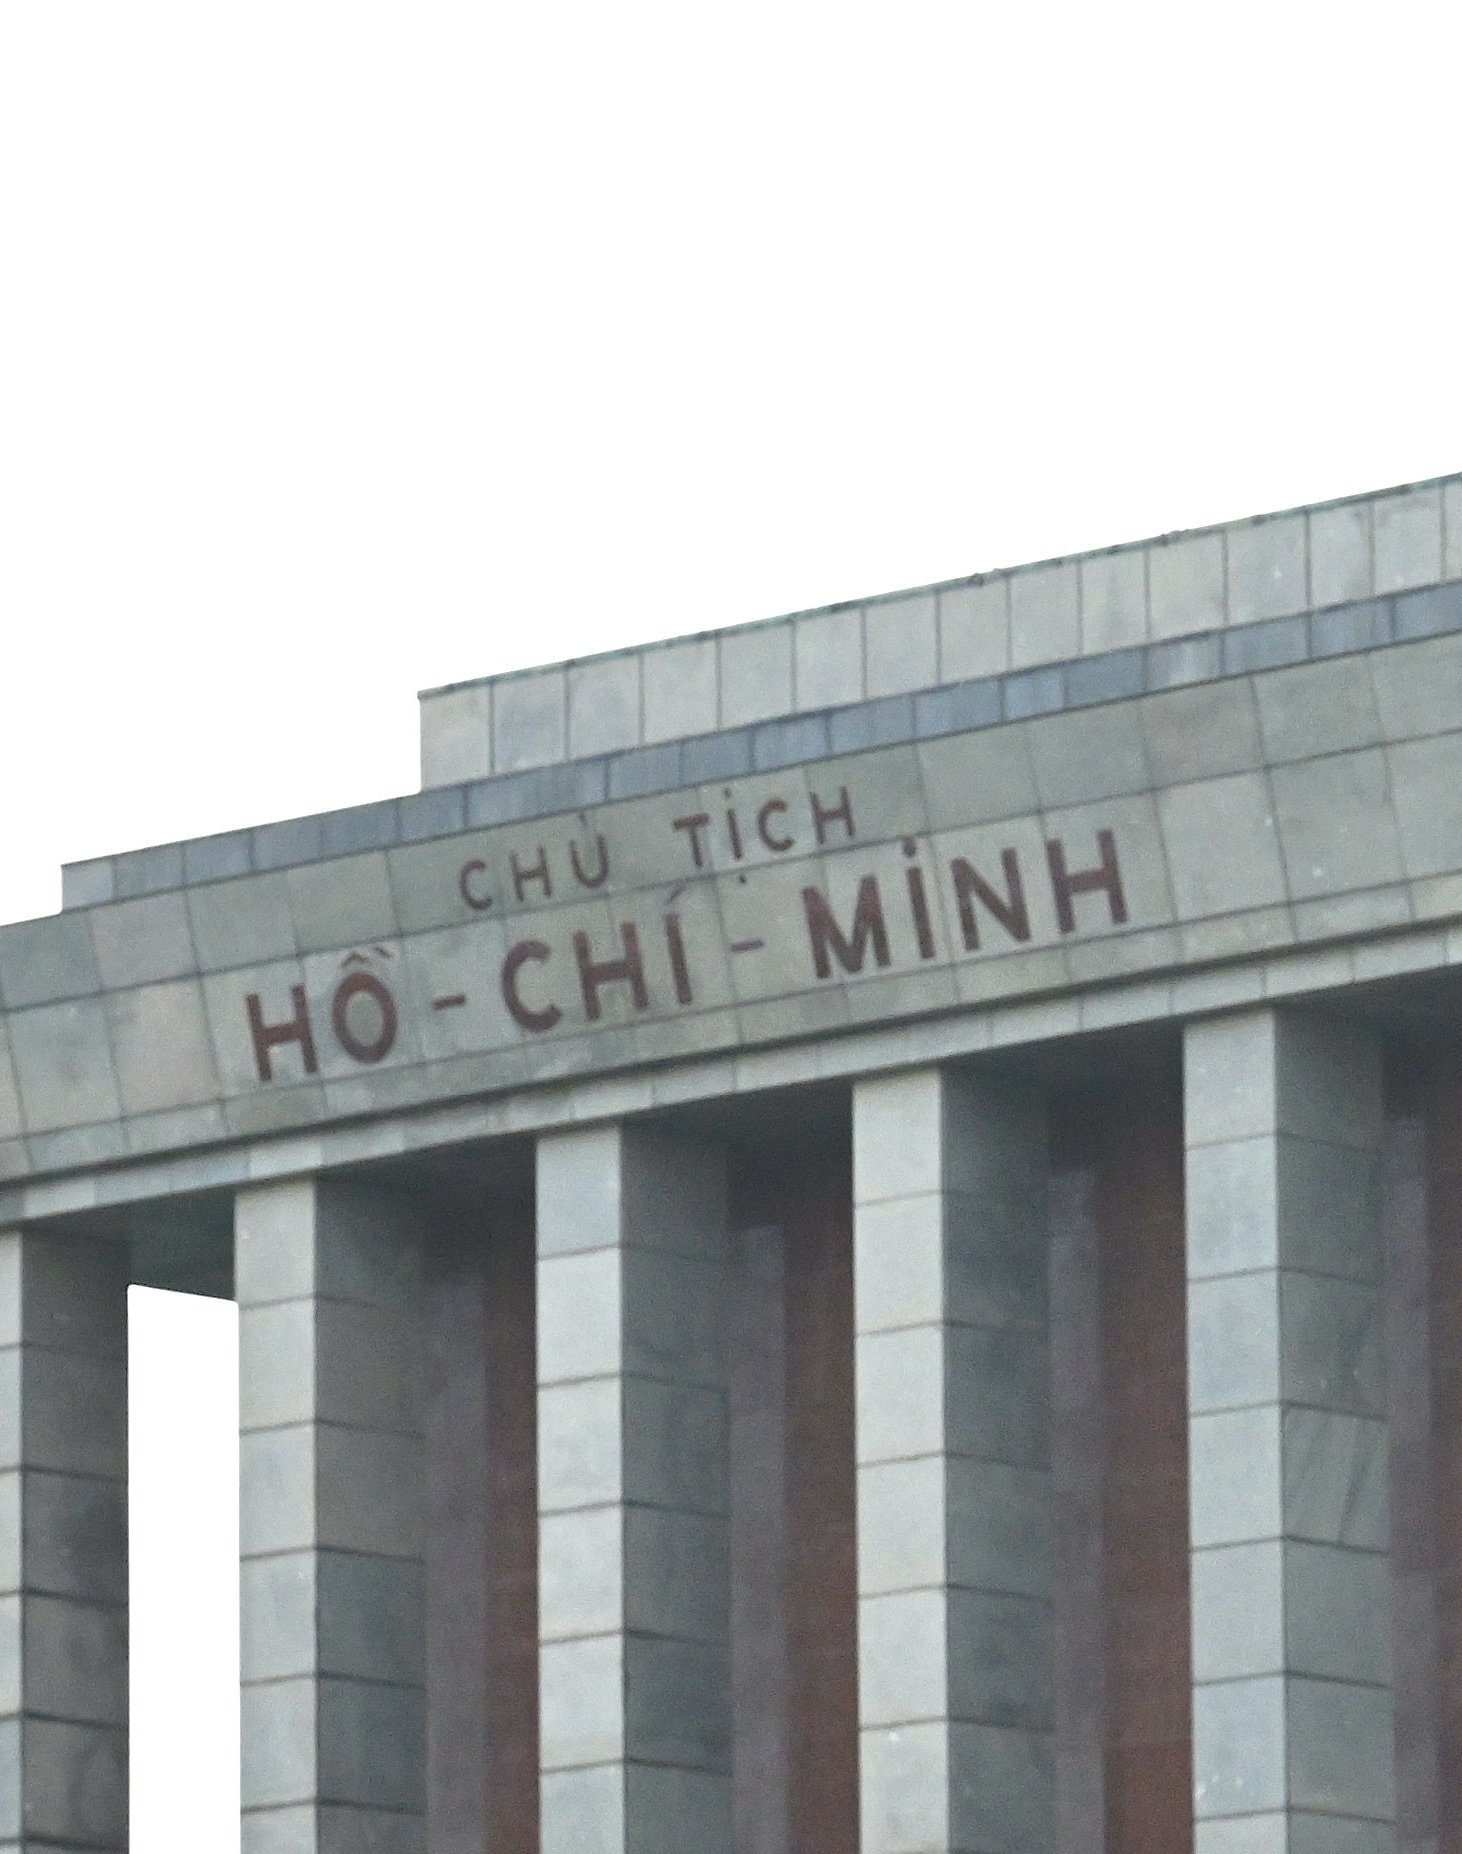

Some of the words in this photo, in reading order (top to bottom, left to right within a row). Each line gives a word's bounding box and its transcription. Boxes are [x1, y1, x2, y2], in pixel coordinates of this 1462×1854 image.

[458, 810, 611, 911] CHỦ
[672, 785, 856, 884] TỊCH
[245, 945, 398, 1082] HỒ
[500, 880, 693, 1034] CHÍ
